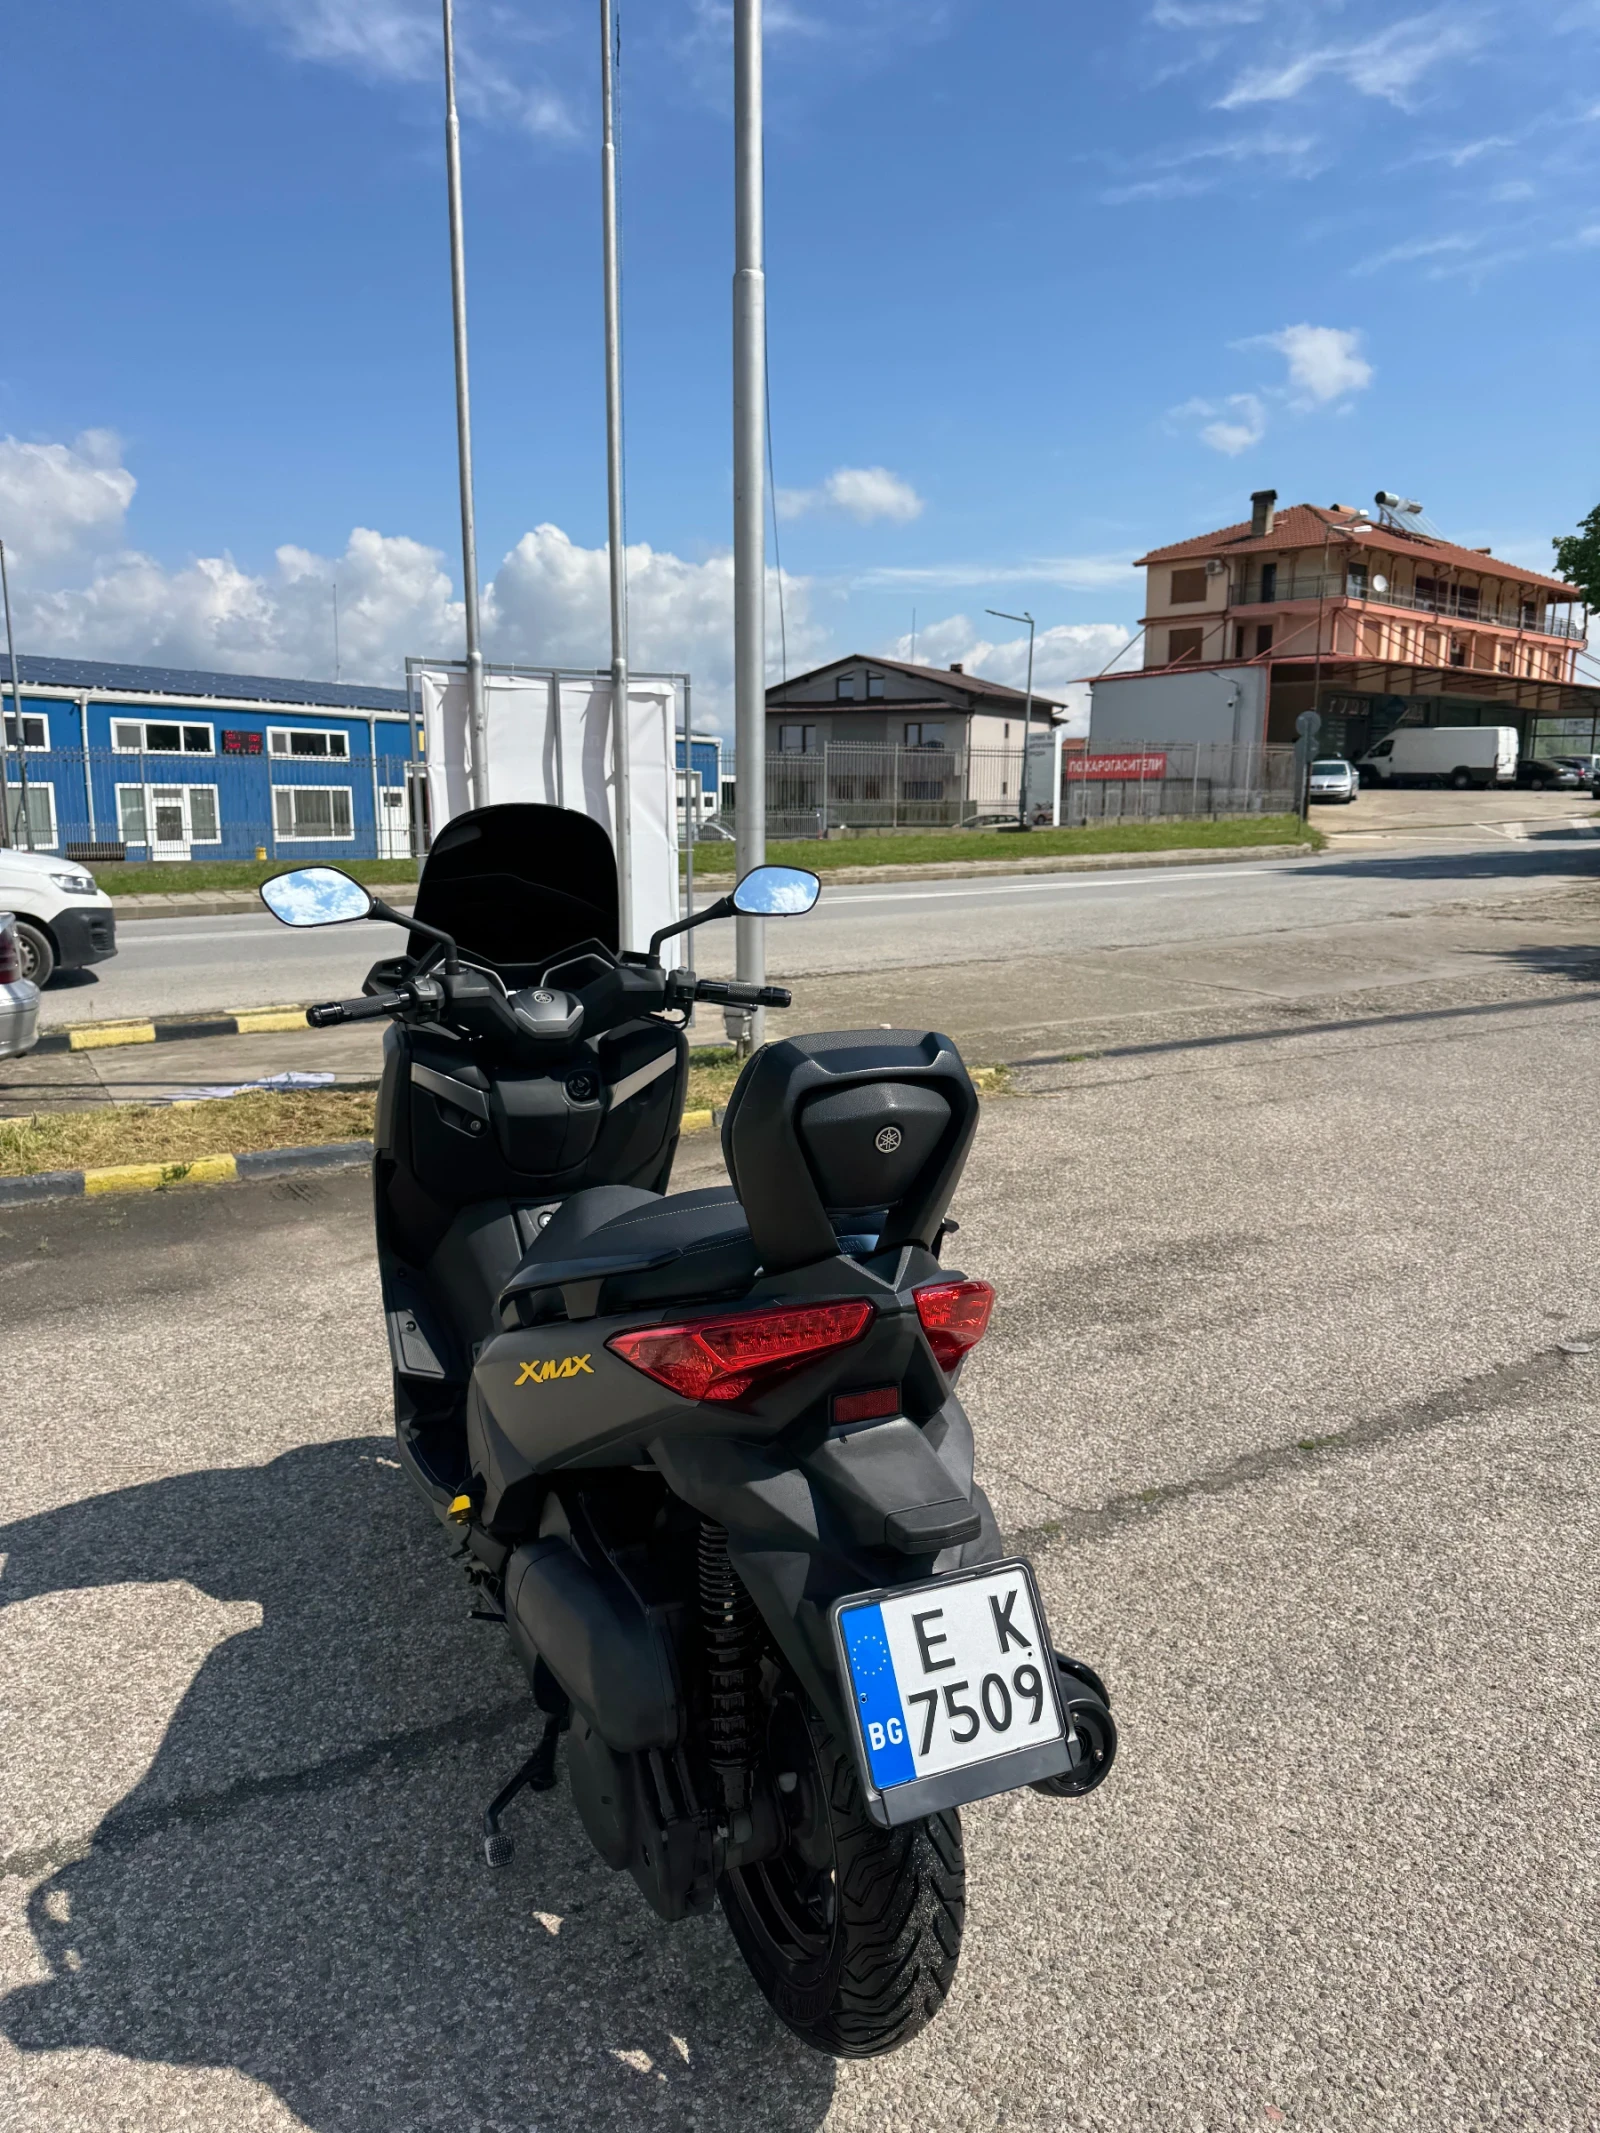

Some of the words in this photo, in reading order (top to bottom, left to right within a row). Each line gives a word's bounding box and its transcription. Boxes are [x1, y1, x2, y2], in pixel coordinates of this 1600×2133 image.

[514, 1353, 595, 1386] XMAX
[911, 1608, 956, 1675] E
[988, 1589, 1032, 1654] K
[868, 1717, 904, 1751] BG
[907, 1664, 1044, 1757] 7509
